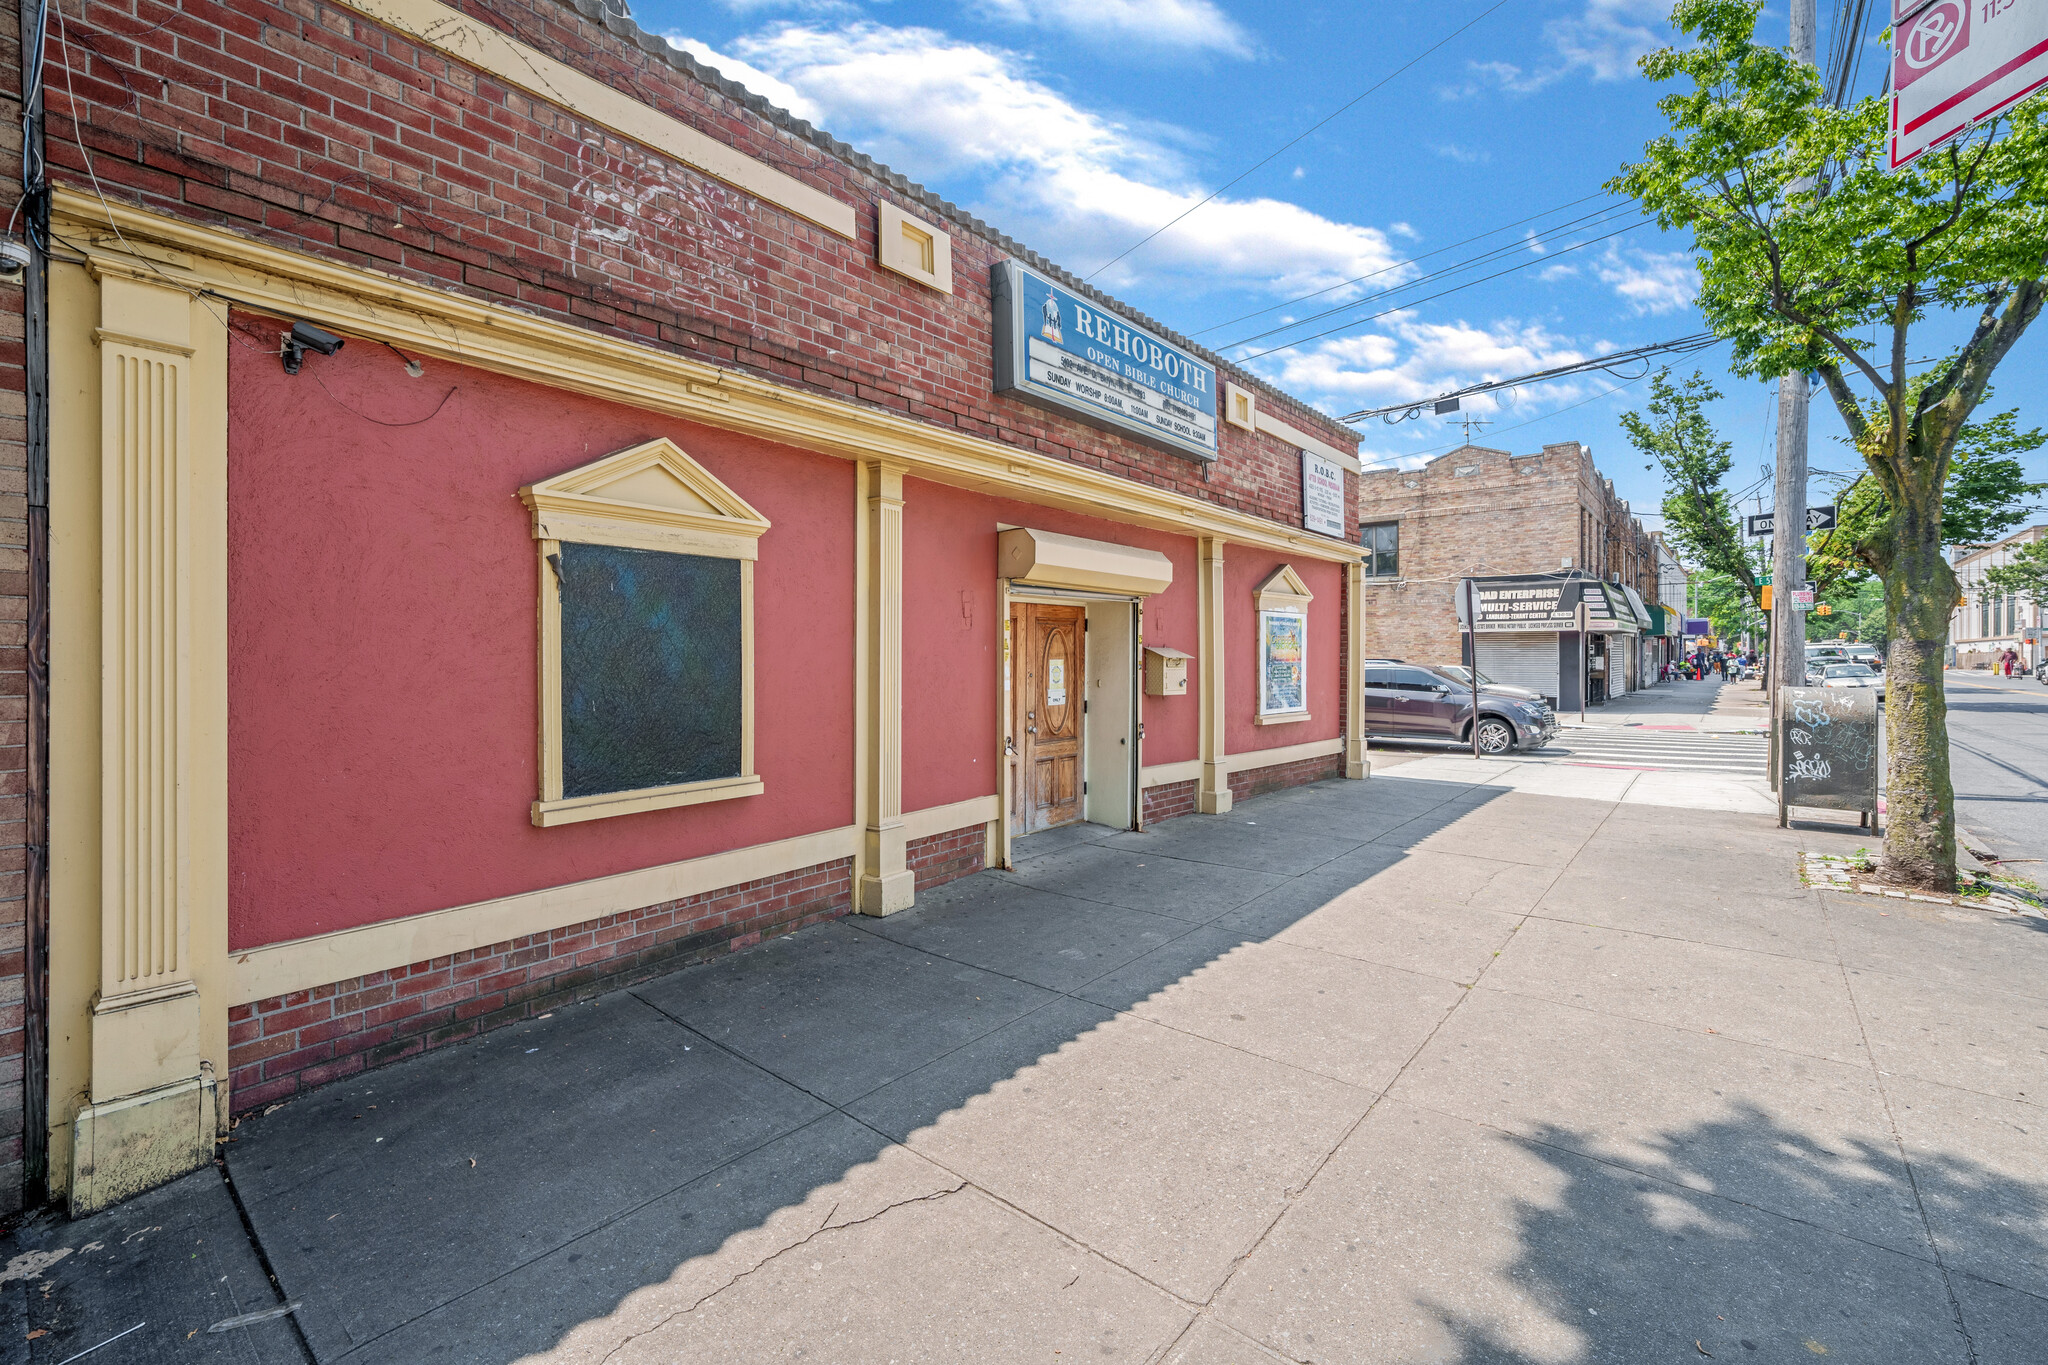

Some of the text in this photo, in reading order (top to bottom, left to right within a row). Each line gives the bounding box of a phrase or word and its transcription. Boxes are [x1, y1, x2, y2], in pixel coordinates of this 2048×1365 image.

[1074, 304, 1207, 393] REHOBOTH
[1086, 346, 1120, 373] OPEN
[1124, 363, 1157, 388] BIBLE
[1160, 380, 1200, 408] CHURCH
[1047, 370, 1072, 388] SUNDAY
[1075, 381, 1102, 400] WORSHIP
[1155, 414, 1173, 429] SUNDAY
[1173, 421, 1191, 436] SCHOOL
[1314, 464, 1336, 480] R.O.B.C.
[1760, 514, 1821, 529] ON AY
[1499, 588, 1560, 600] ENTERPRISE
[1480, 600, 1558, 611] MULTI-SERVICE
[1486, 612, 1529, 620] LANDLORD-TENANT
